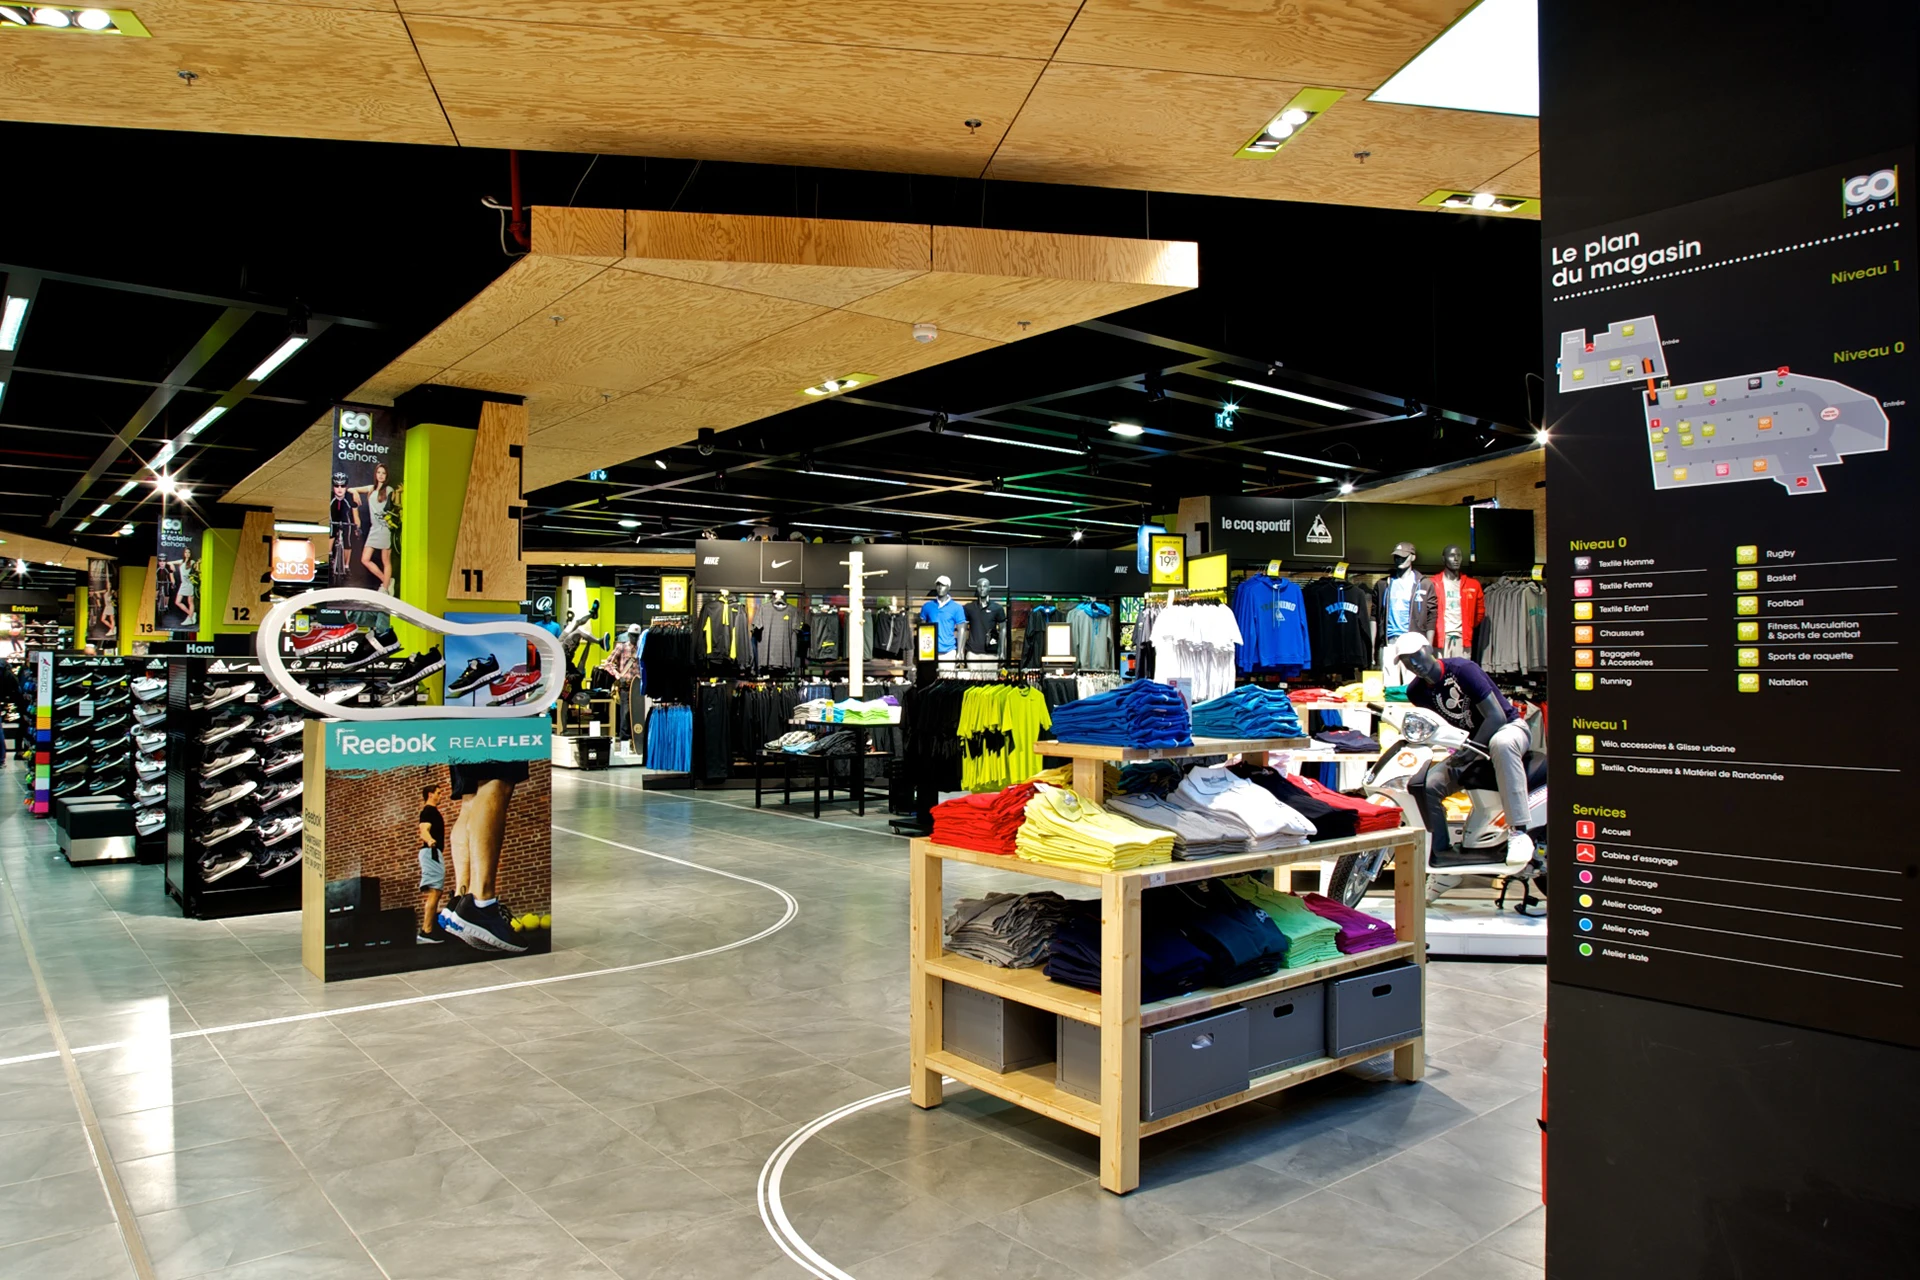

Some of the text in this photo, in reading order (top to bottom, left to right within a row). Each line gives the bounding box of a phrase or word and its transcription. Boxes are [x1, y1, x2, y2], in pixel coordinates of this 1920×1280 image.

[1844, 169, 1896, 206] GO
[1846, 199, 1896, 217] SPORT
[1552, 232, 1640, 266] Le plan
[1552, 240, 1702, 287] du magasin
[1831, 260, 1900, 284] Niveau 1
[1833, 341, 1905, 363] Niveau 0
[341, 411, 371, 433] GO
[342, 431, 370, 440] SPORT
[338, 439, 389, 454] S'éclater
[338, 450, 380, 463] dehors.
[1221, 516, 1291, 533] le coq sportif
[1570, 537, 1627, 551] Niveau 0
[1766, 550, 1796, 559] Rugby
[703, 556, 720, 566] NIKE
[915, 561, 930, 570] NIKE
[1599, 558, 1655, 568] Textile Homme
[275, 563, 310, 575] SHOES
[1114, 566, 1128, 574] NIKE
[461, 569, 484, 592] 11
[1766, 573, 1797, 582] Basket
[1599, 582, 1623, 590] Textile
[1623, 581, 1653, 589] Femme
[11, 605, 39, 613] Enfant
[1599, 604, 1649, 613] Textile Enfant
[1767, 599, 1804, 608] Football
[232, 607, 250, 621] 12
[140, 623, 154, 633] 13
[1801, 621, 1860, 630] Musculation
[1600, 629, 1645, 637] Chaussures
[1768, 630, 1861, 641] & Sports de combat
[186, 643, 214, 653] Hom
[1600, 650, 1640, 659] Bagagerie
[1768, 652, 1854, 662] Sports de raquette
[1600, 659, 1607, 667] &
[1607, 658, 1654, 667] Accessoires
[1600, 677, 1632, 687] Running
[1768, 678, 1809, 687] Natation
[1572, 718, 1628, 730] Niveau 1
[342, 733, 544, 755] Reebok REALFLEX
[1620, 741, 1667, 750] accessoires
[1668, 743, 1675, 751] &
[1676, 743, 1701, 752] Glisse
[1702, 744, 1736, 753] urbaine
[1627, 765, 1673, 775] Chaussures
[1674, 767, 1682, 776] &
[1682, 768, 1717, 778] Matériel
[1718, 770, 1731, 778] de
[1732, 771, 1784, 781] Randonnée
[1573, 804, 1627, 818] Services
[1601, 827, 1632, 837] Accueil
[1602, 851, 1679, 867] Cabine d'essayage
[1602, 874, 1659, 889] Atelier flocage
[1602, 899, 1663, 915] Atelier cordage
[1602, 923, 1650, 937] Atelier cycle
[1602, 948, 1649, 962] Atelier skate
